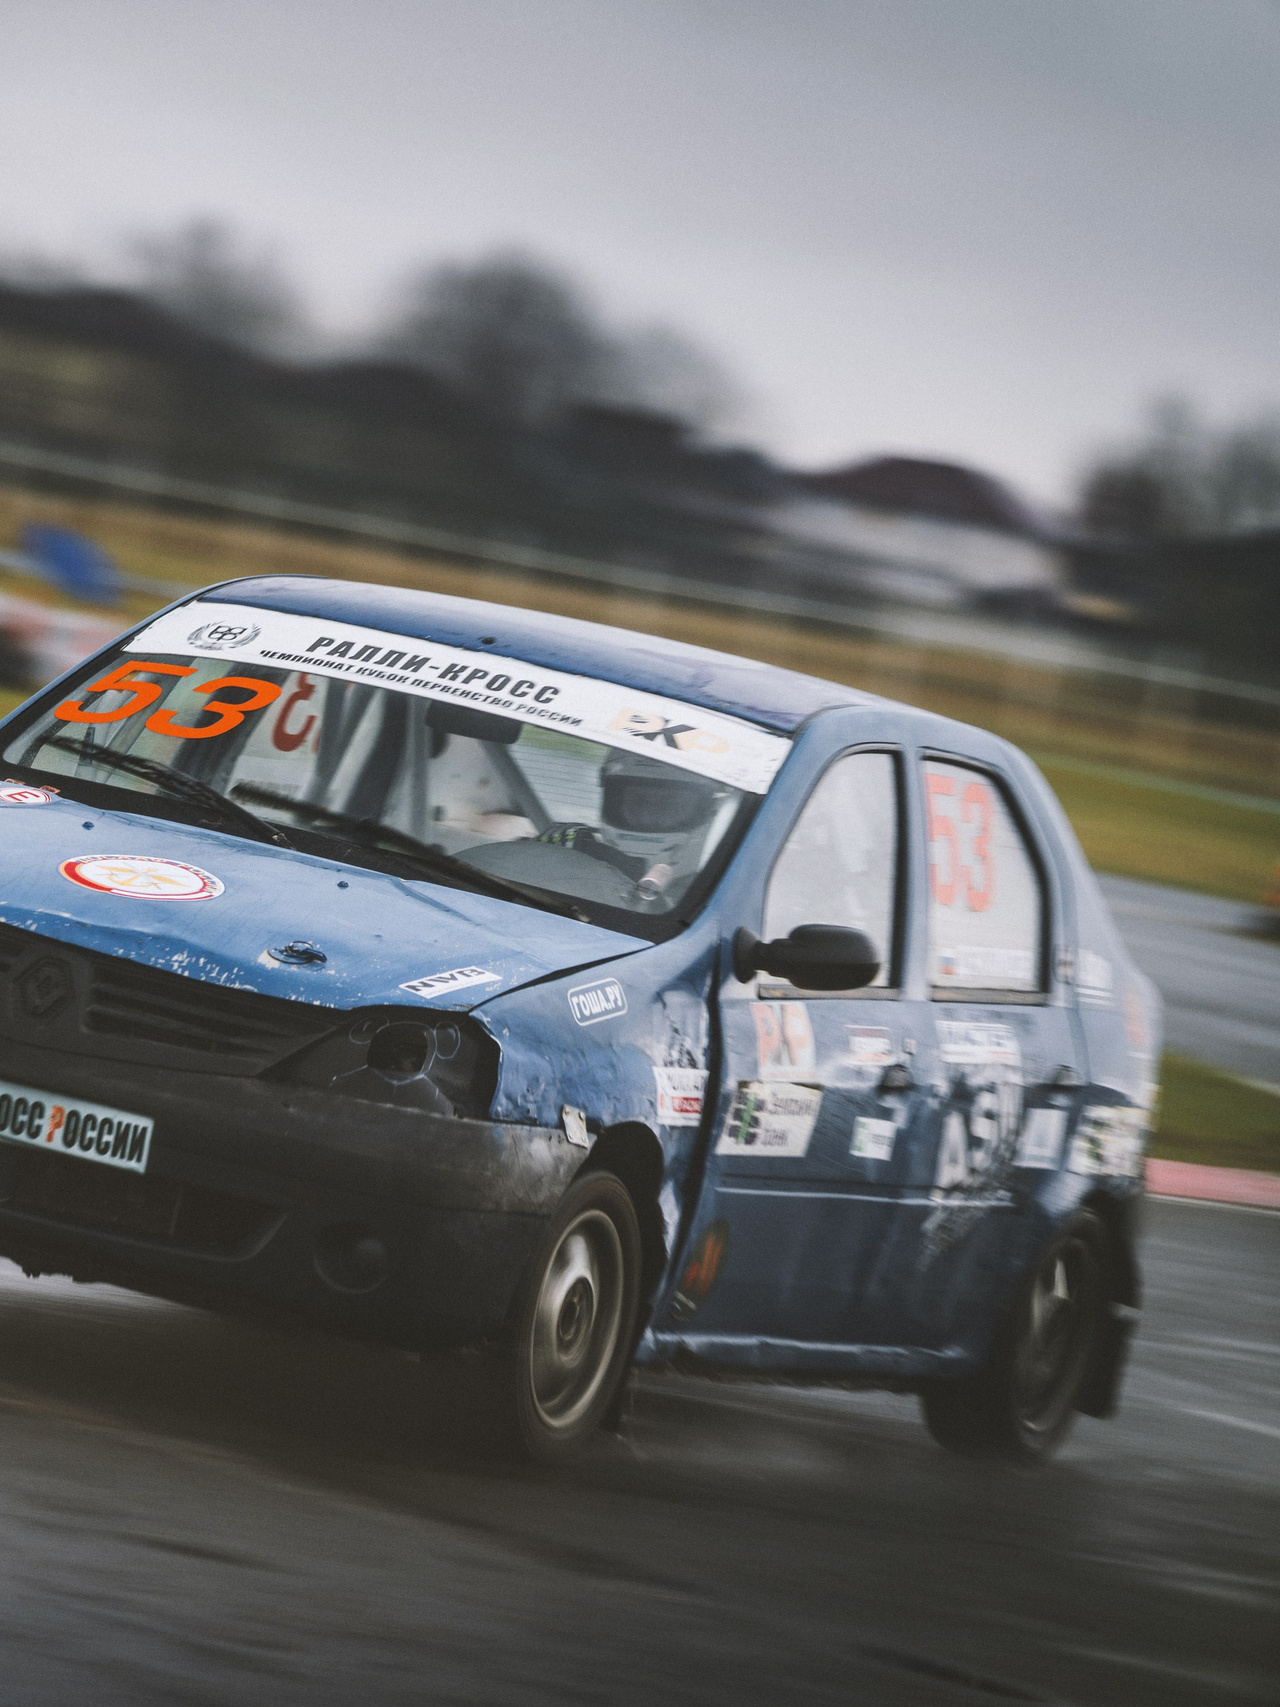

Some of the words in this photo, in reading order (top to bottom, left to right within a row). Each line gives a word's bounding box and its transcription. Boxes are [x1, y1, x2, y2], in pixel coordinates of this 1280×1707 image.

[54, 660, 283, 739] 53
[260, 649, 355, 672] ЧЕМПИОНАТ
[356, 666, 411, 684] КУБОК
[410, 678, 513, 708] ПЕРВЕНСТВО
[514, 704, 583, 727] РОССИИ
[306, 636, 560, 704] РАЛЛИ-КРОСС
[924, 773, 995, 913] 53
[570, 984, 623, 1019] ГОША.РУ
[45, 1104, 149, 1164] РОССИИ
